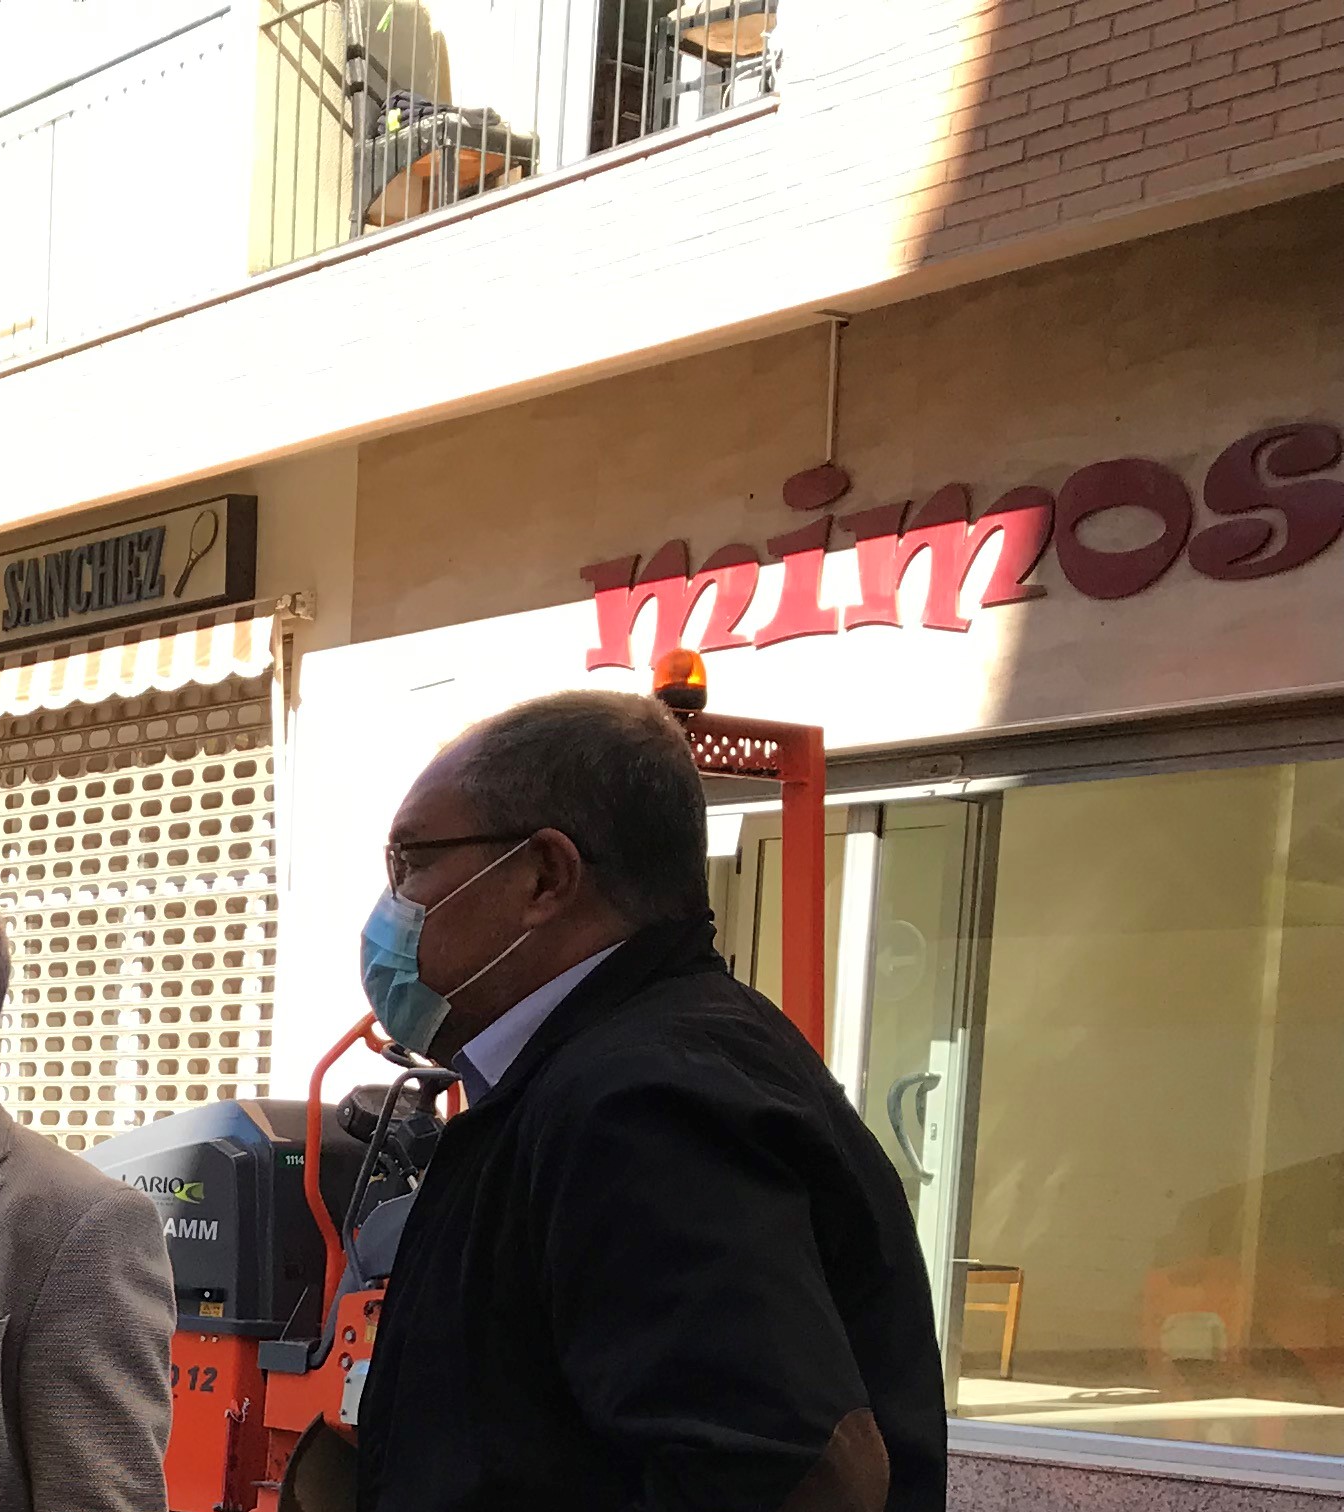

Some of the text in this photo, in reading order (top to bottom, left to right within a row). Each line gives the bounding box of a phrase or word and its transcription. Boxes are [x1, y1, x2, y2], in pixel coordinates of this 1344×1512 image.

[2, 525, 167, 632] SANCHEZ
[580, 422, 1344, 672] mimos
[162, 1217, 219, 1241] AMM
[187, 1365, 219, 1392] 12
